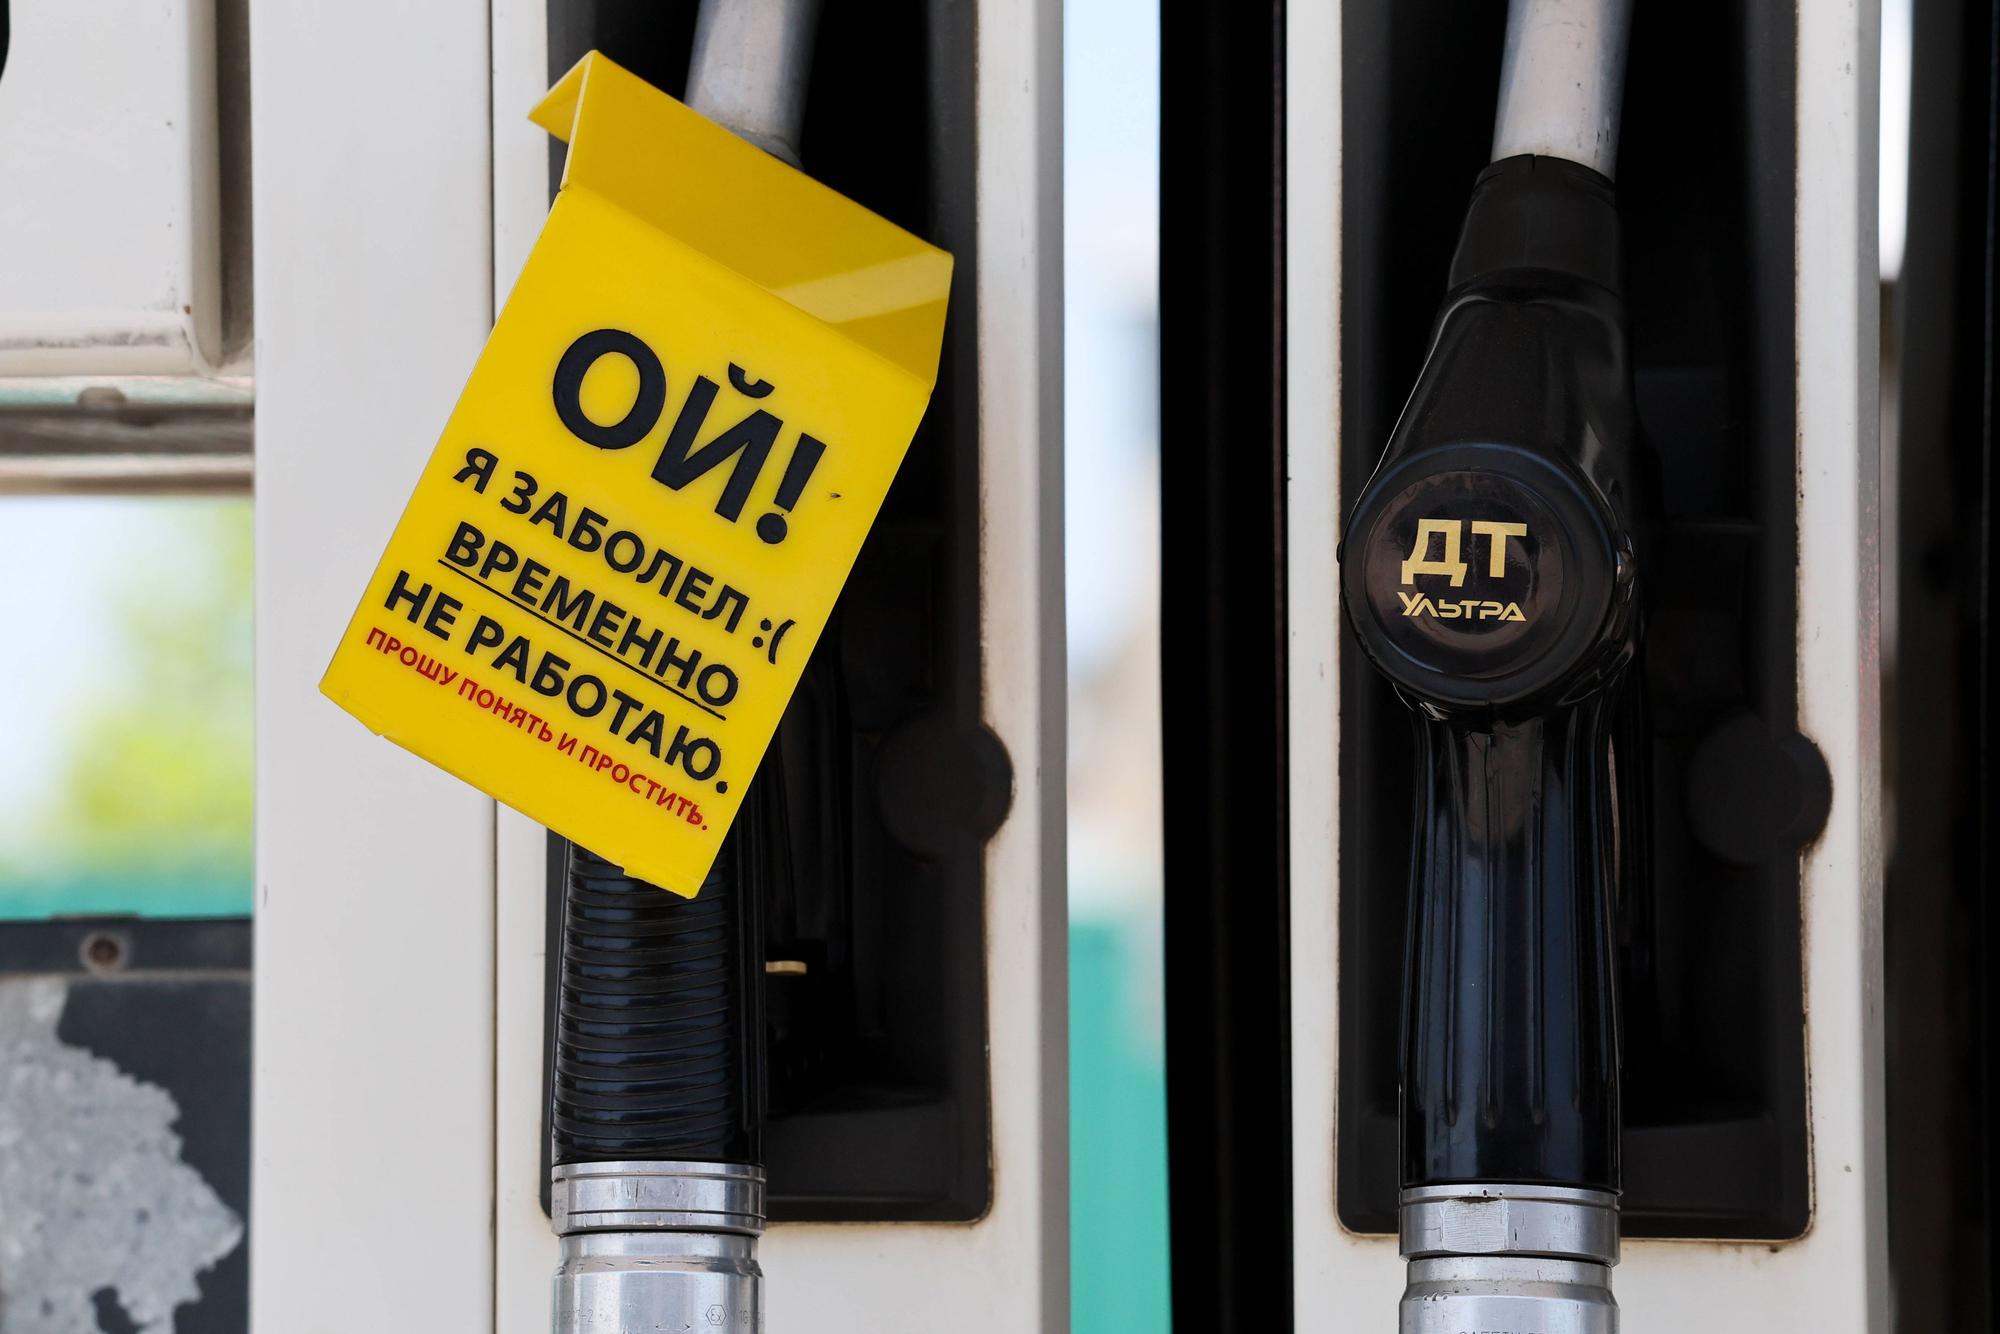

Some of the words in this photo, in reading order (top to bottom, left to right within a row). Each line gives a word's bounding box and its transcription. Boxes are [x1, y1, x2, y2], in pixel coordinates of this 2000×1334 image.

[551, 328, 827, 545] ОЙ!
[444, 521, 739, 707] ВРЕМЕННО
[452, 447, 499, 495] Я
[499, 470, 750, 634] ЗАБОЛЕЛ
[1396, 591, 1528, 622] УЛЬТРА
[1401, 518, 1528, 587] ДТ
[366, 627, 459, 686] ПРОШУ
[458, 677, 553, 743] ПОНЯТЬ
[557, 732, 578, 756] И
[579, 744, 708, 831] ПРОСТИТЬ.
[383, 569, 464, 641] НЕ
[464, 615, 728, 795] РАБОТАЮ.
